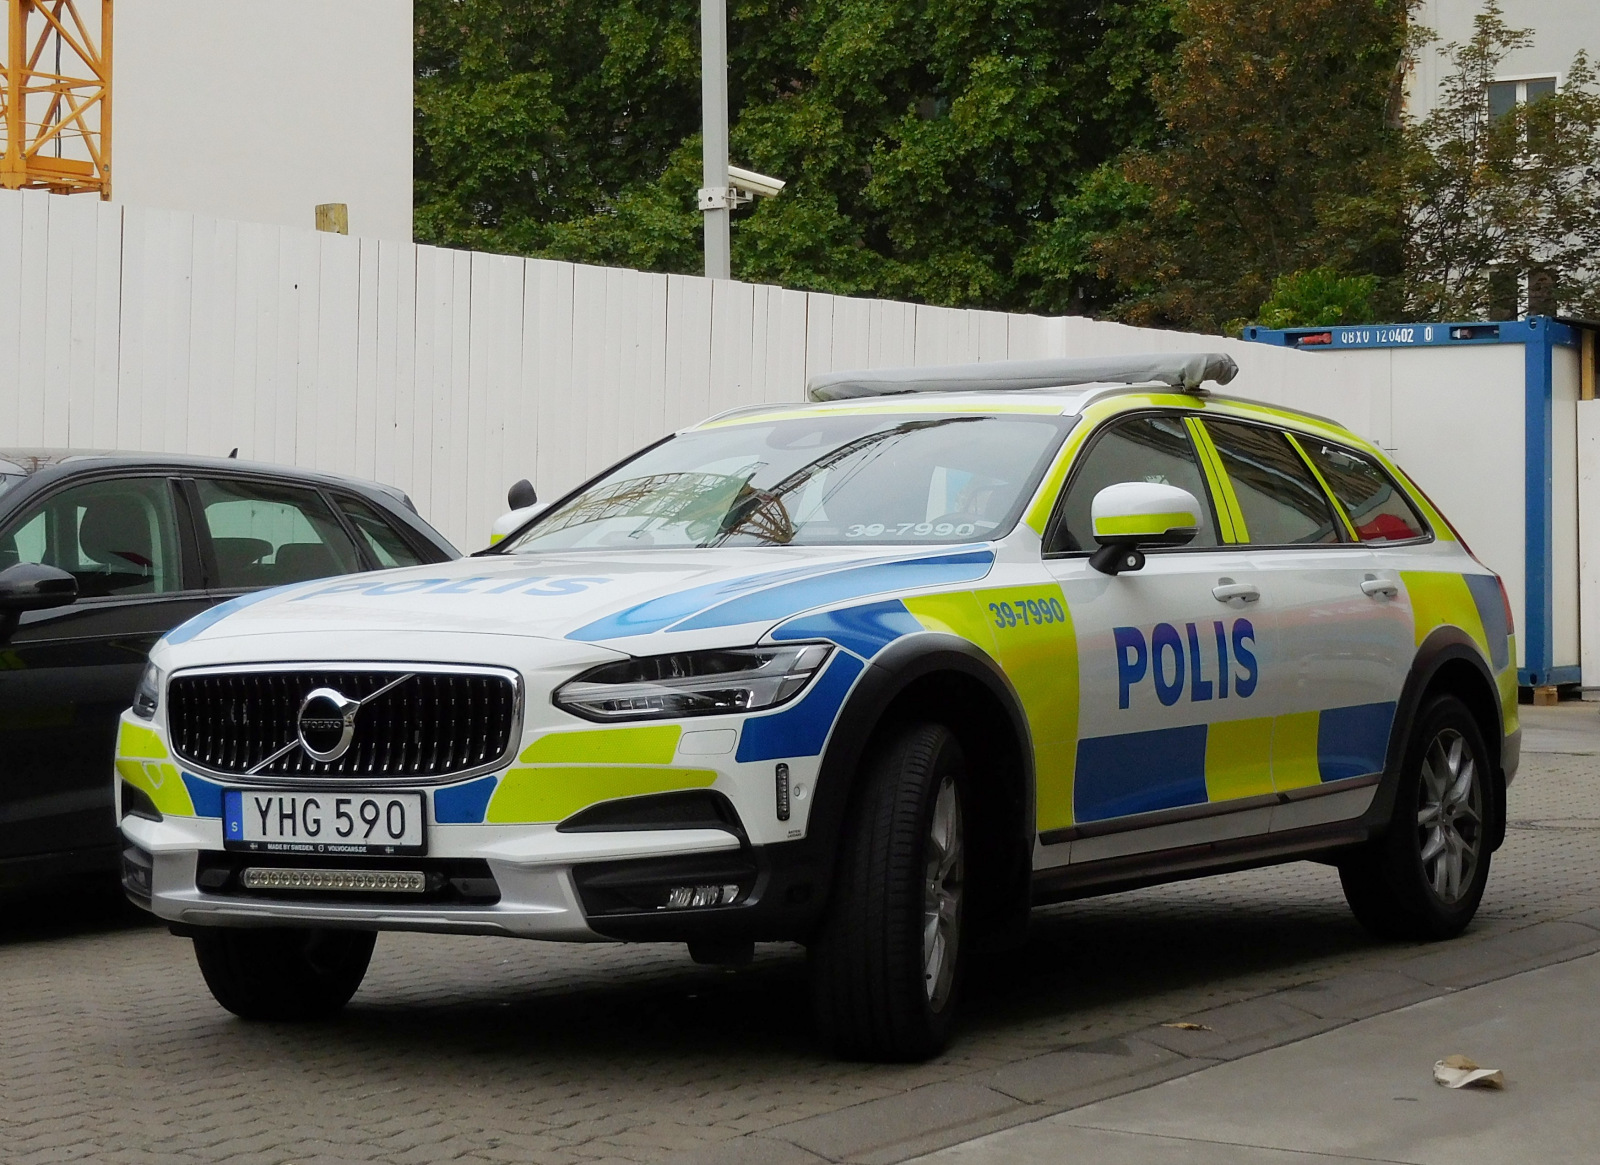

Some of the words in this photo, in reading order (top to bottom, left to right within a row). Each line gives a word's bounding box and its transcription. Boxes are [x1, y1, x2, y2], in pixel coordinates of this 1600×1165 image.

[1376, 328, 1414, 343] 120402
[1425, 326, 1432, 341] 0
[845, 523, 975, 537] 39-7990
[287, 577, 614, 602] POLIS
[988, 597, 1066, 629] 39-7990
[1112, 617, 1258, 710] POLIS
[301, 720, 341, 729] VOLVO
[254, 796, 321, 837] YHG
[335, 798, 406, 839] 590
[231, 821, 239, 832] S
[283, 843, 291, 851] BY
[328, 845, 367, 853] VOLVOCARS.DE
